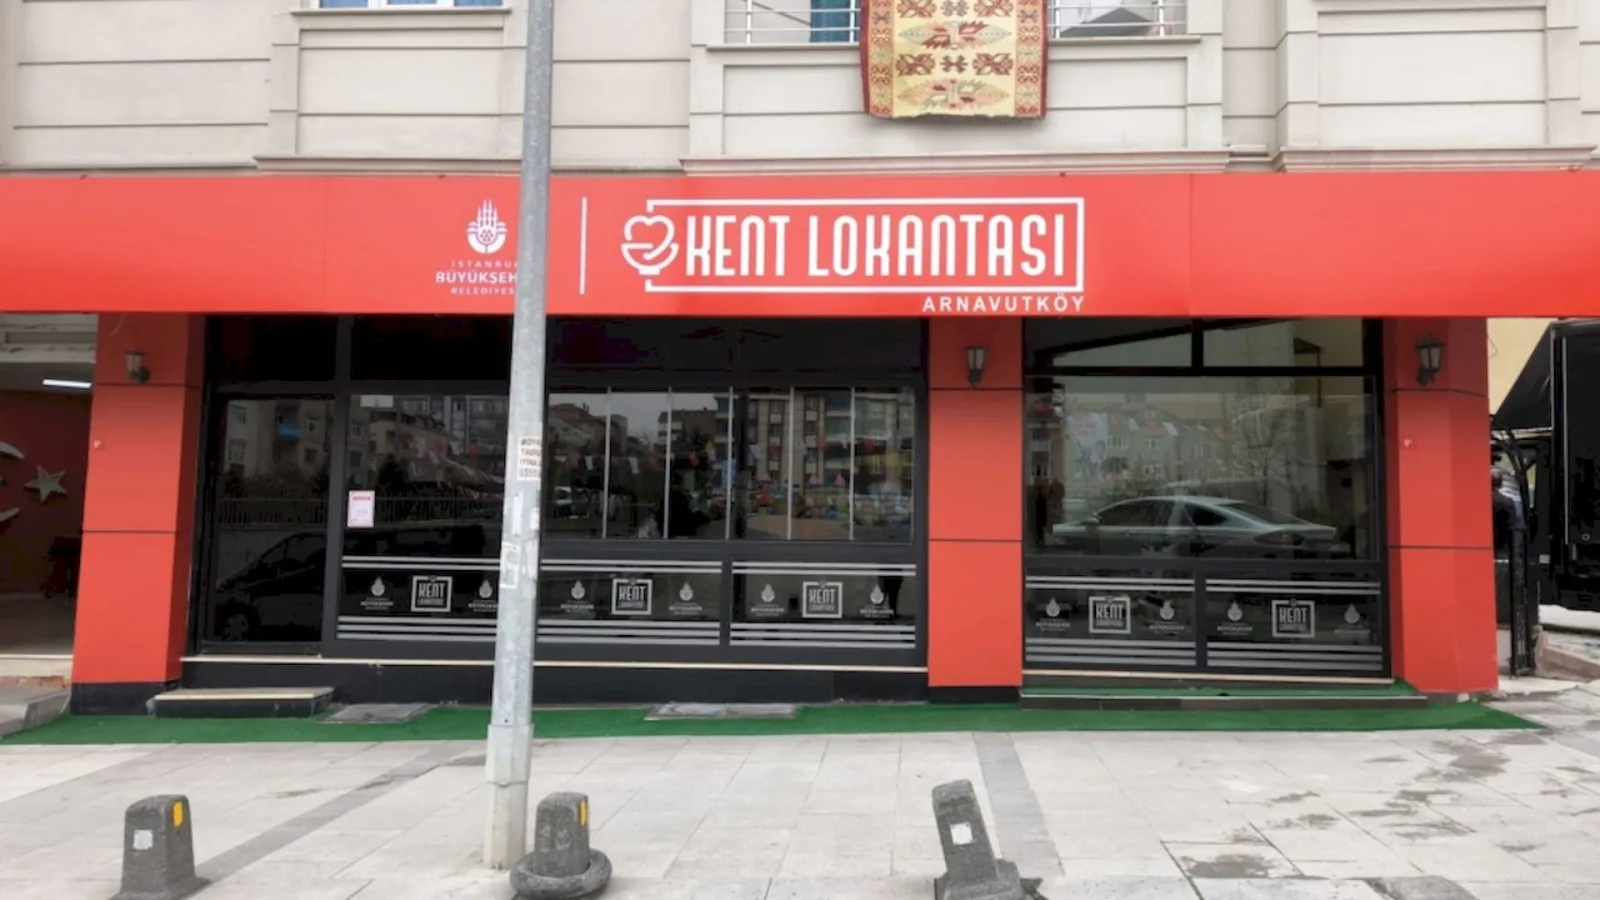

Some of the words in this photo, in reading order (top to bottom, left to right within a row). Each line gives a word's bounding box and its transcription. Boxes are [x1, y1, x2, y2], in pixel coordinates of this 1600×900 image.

[685, 214, 790, 276] KENT
[808, 213, 1065, 276] LOKANTASI
[435, 269, 518, 285] BÜYÜKŞEH
[922, 291, 1084, 312] ARNAVUTKÖY
